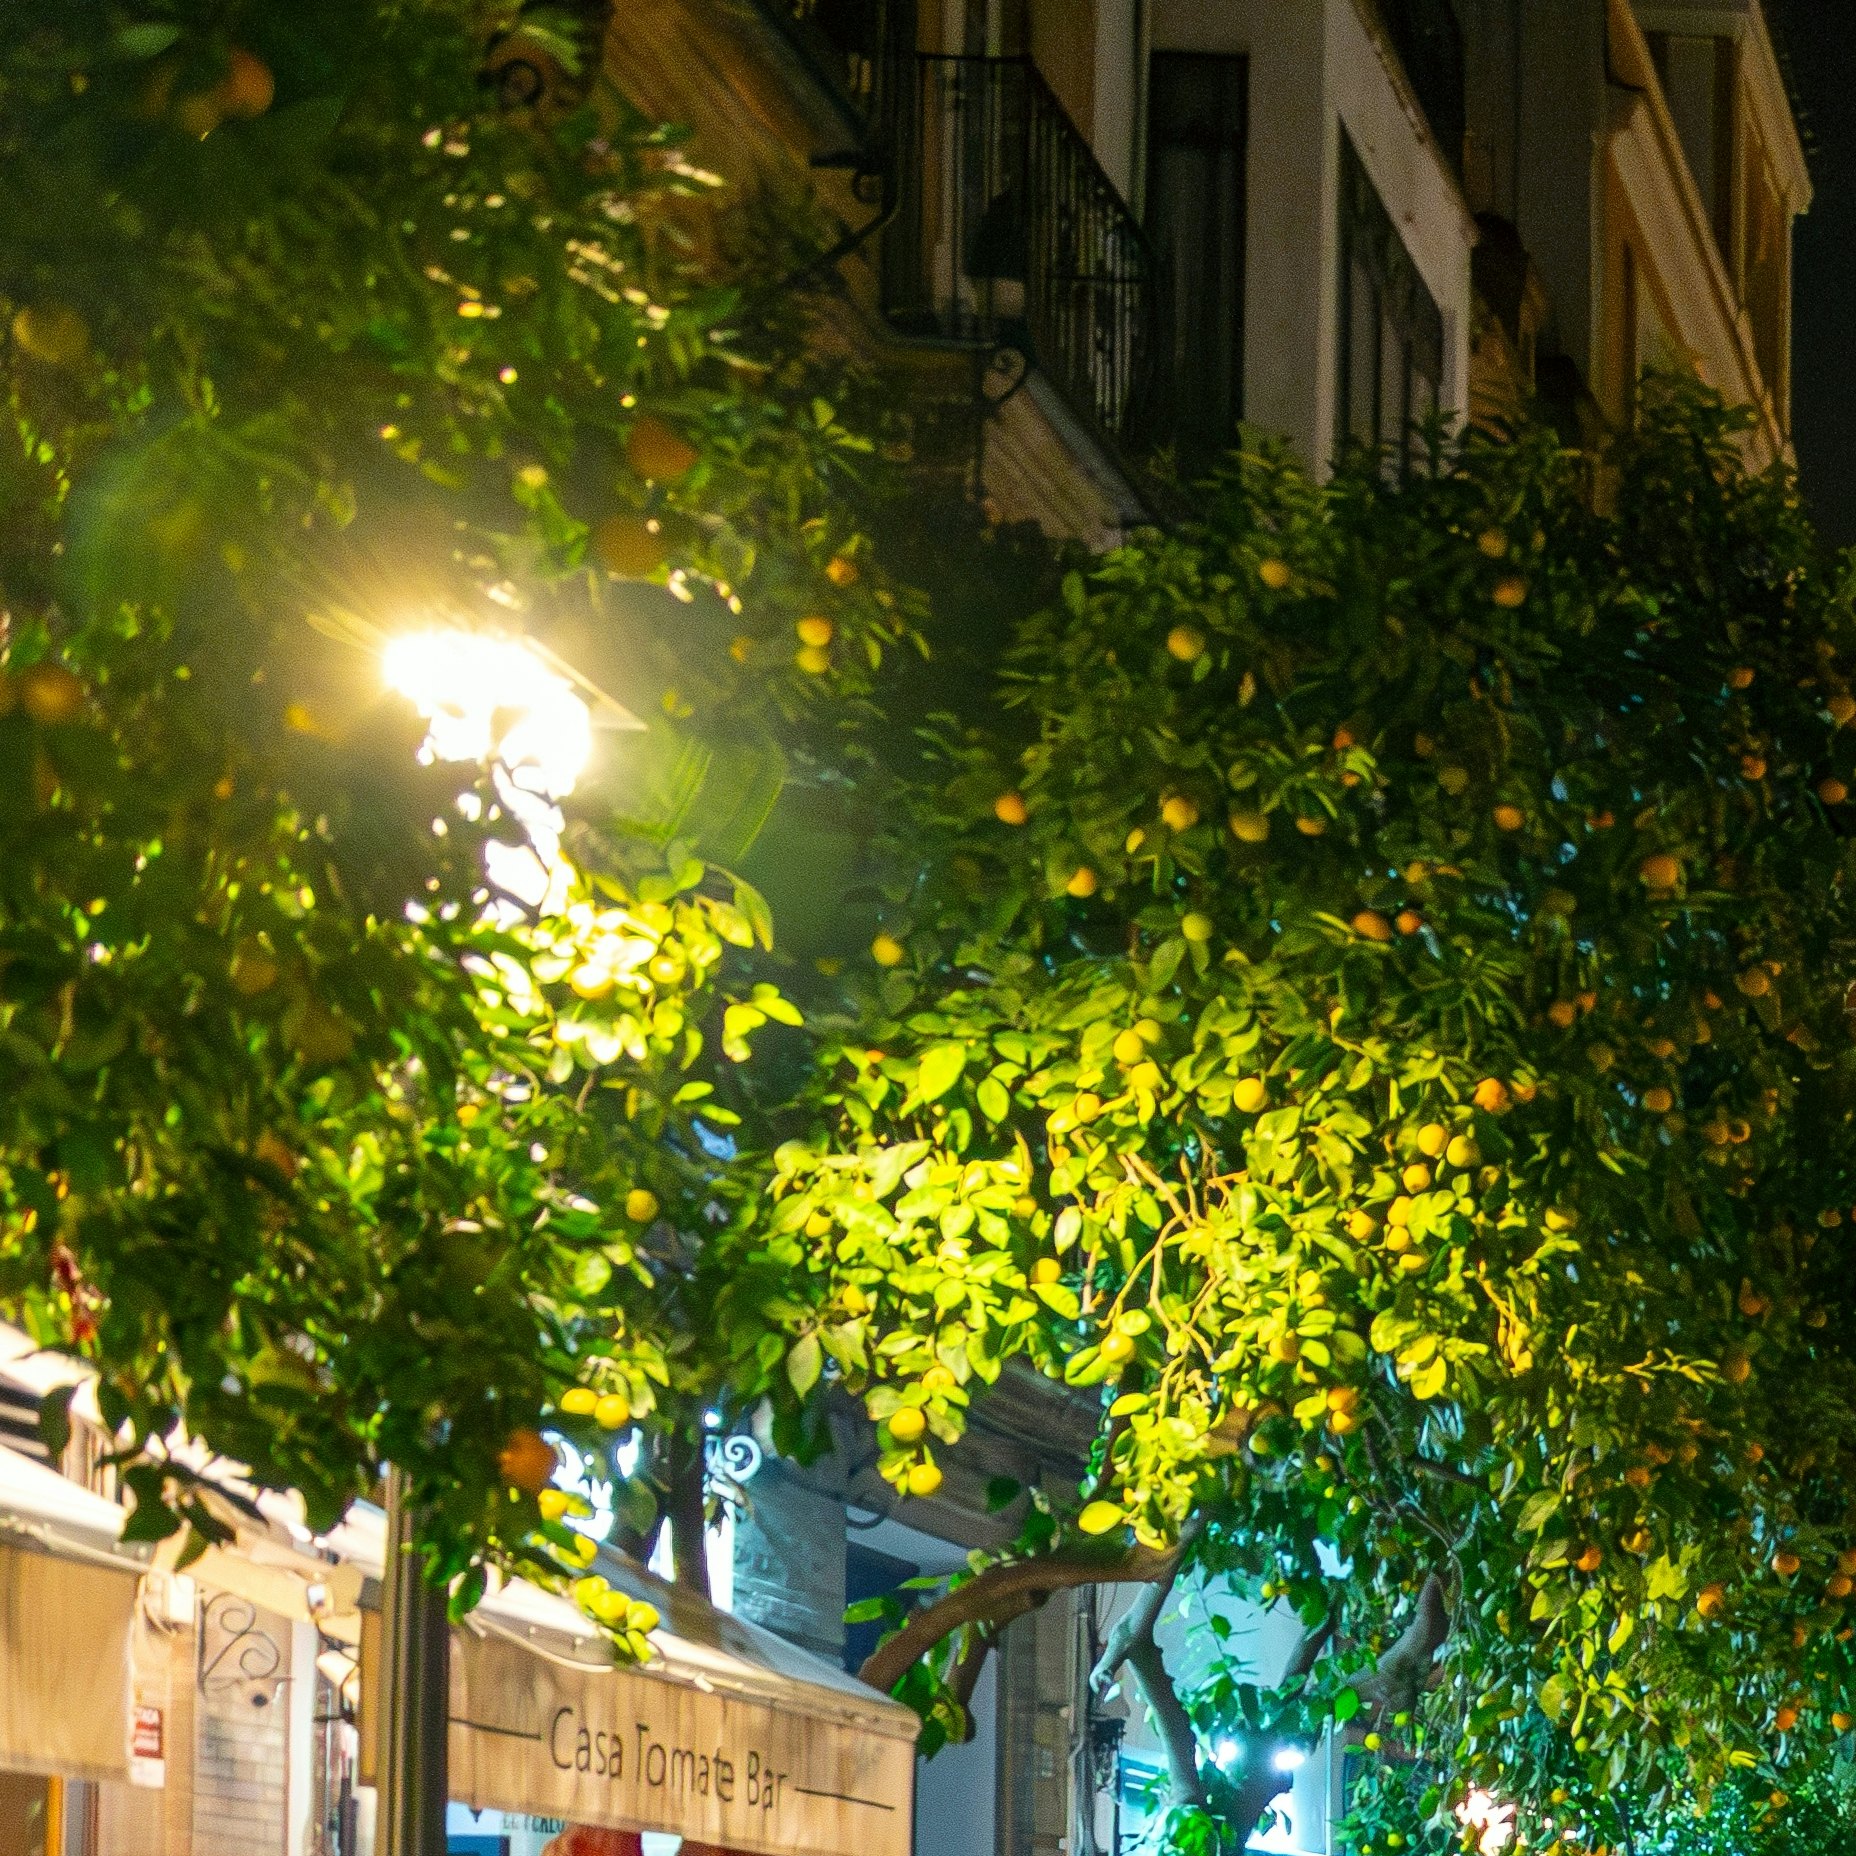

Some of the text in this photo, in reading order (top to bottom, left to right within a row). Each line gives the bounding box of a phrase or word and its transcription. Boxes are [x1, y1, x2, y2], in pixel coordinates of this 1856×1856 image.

[549, 1706, 789, 1810] Casa Tomate Bar
